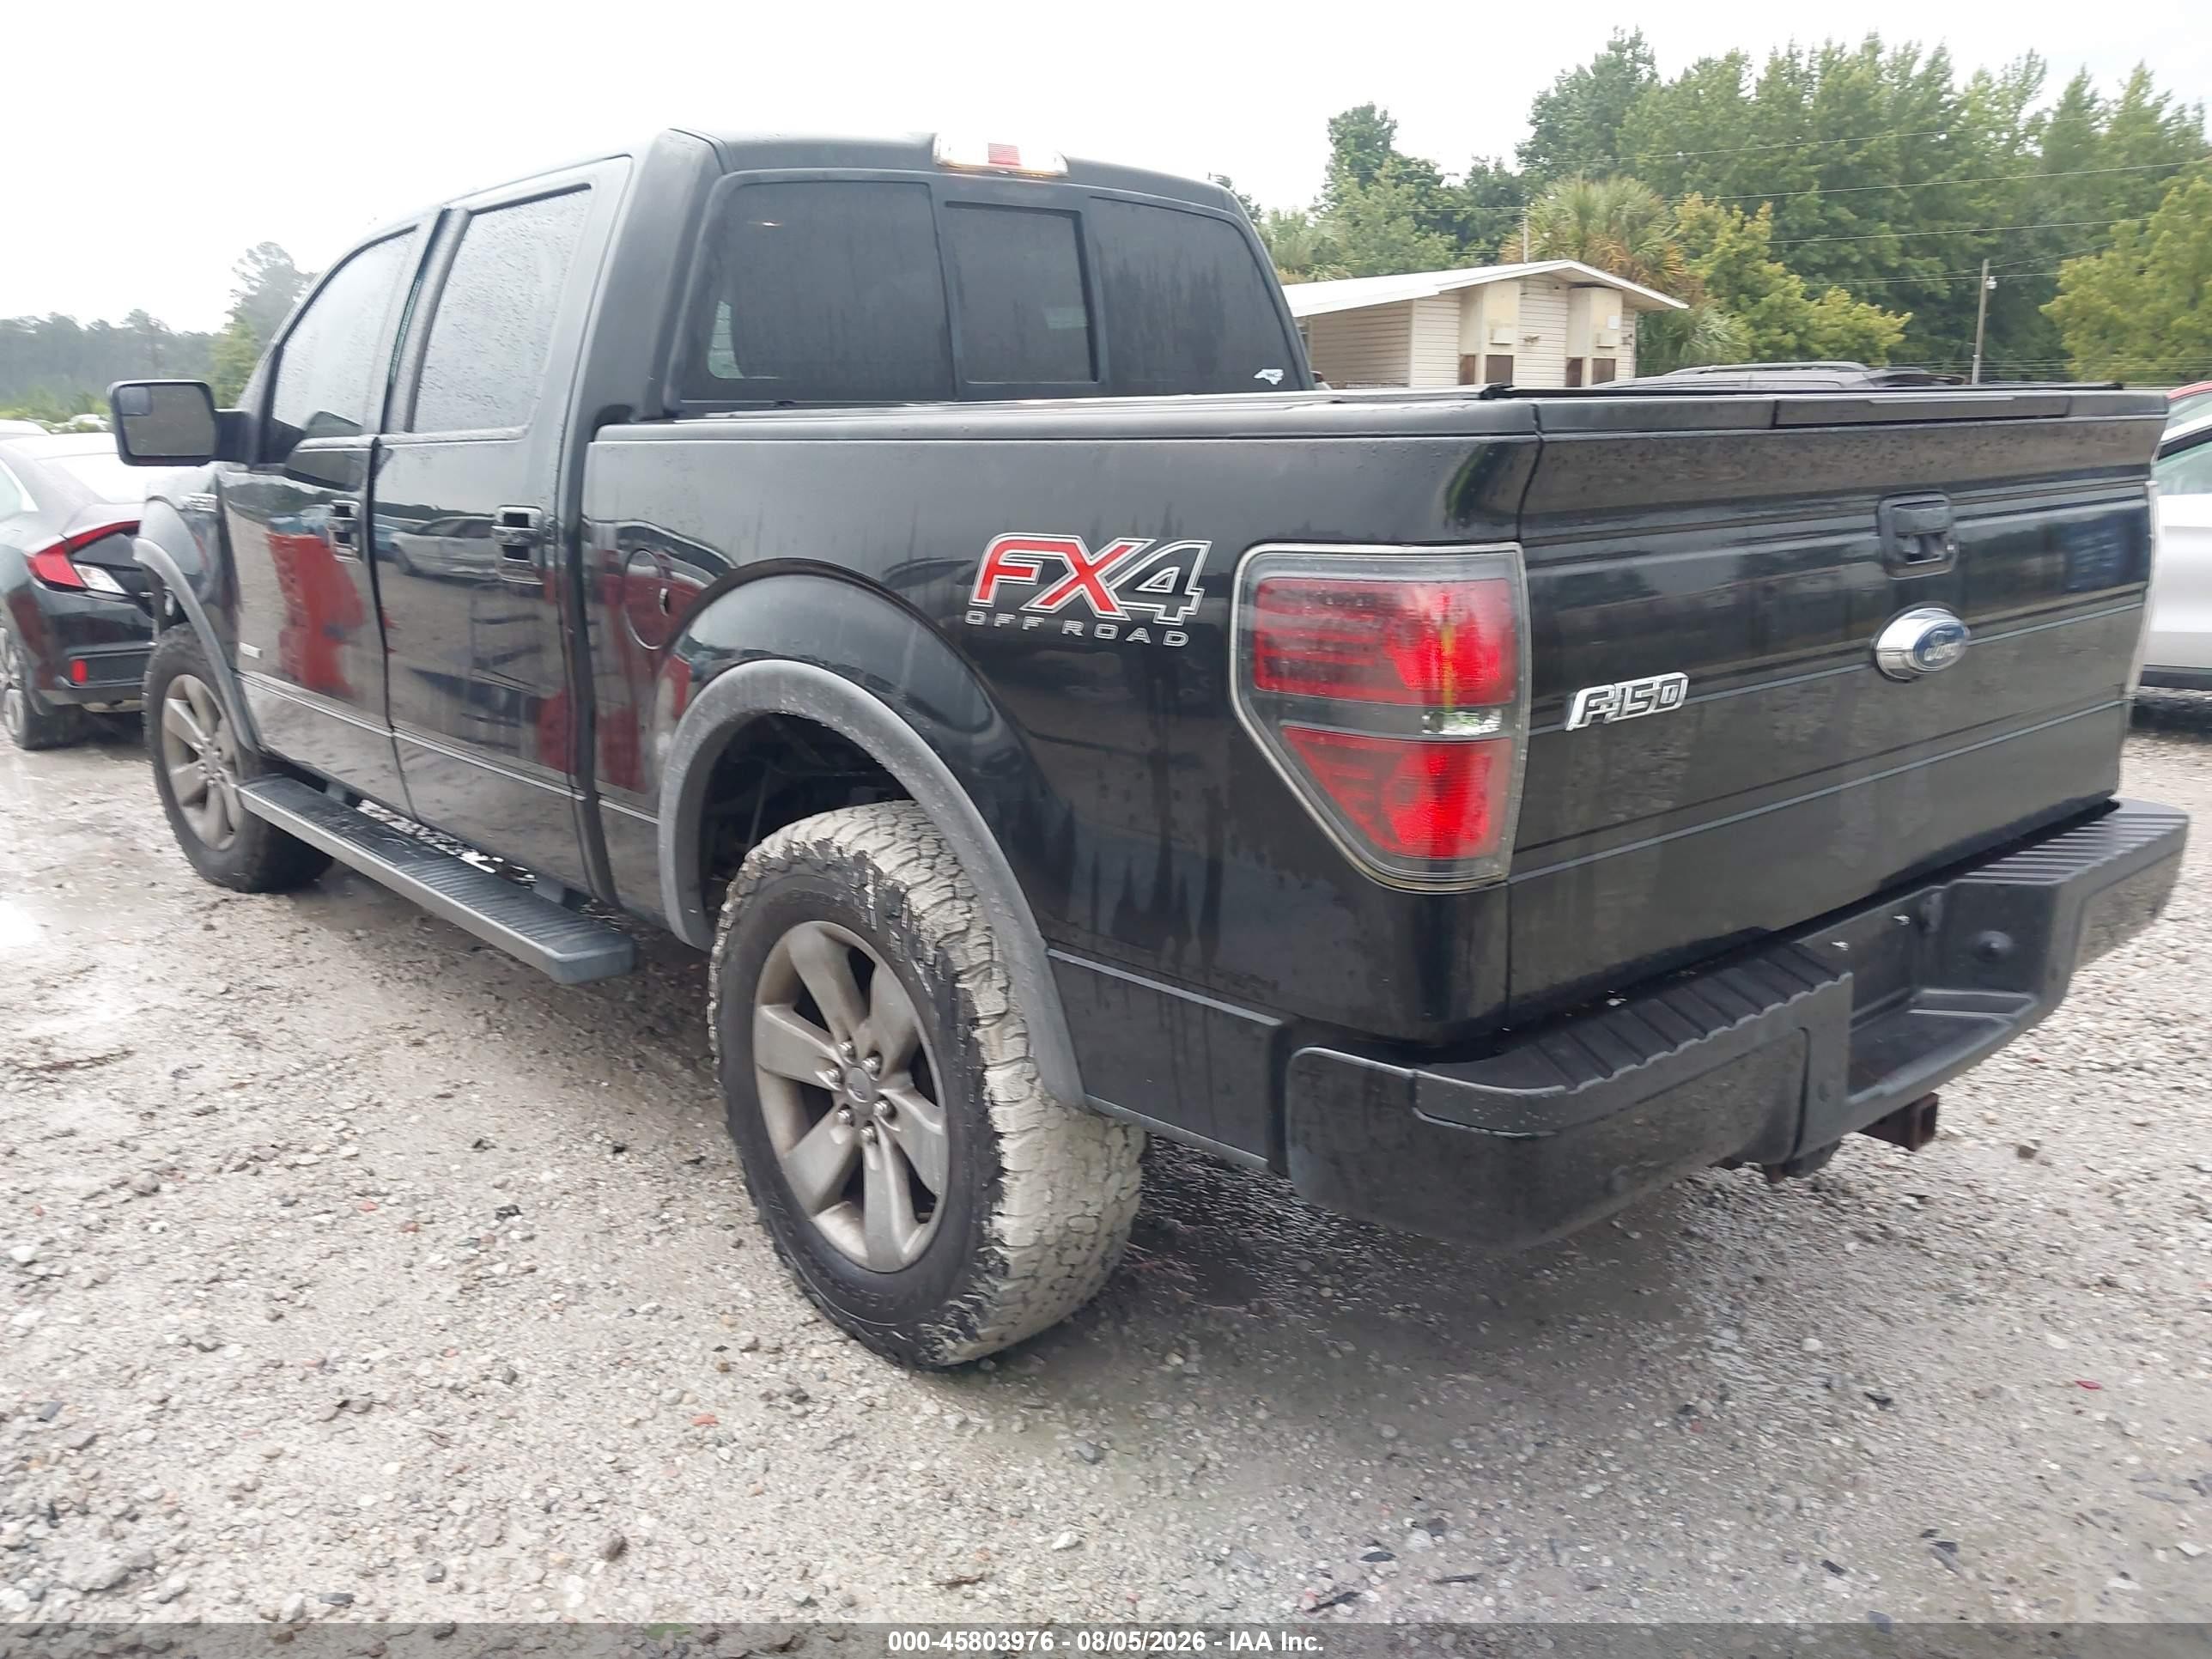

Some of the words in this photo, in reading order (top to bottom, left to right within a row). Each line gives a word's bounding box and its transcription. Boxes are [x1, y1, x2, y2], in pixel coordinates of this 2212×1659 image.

[968, 532, 1212, 626] FX4
[964, 610, 1045, 631] OFF
[1060, 619, 1189, 647] ROAD
